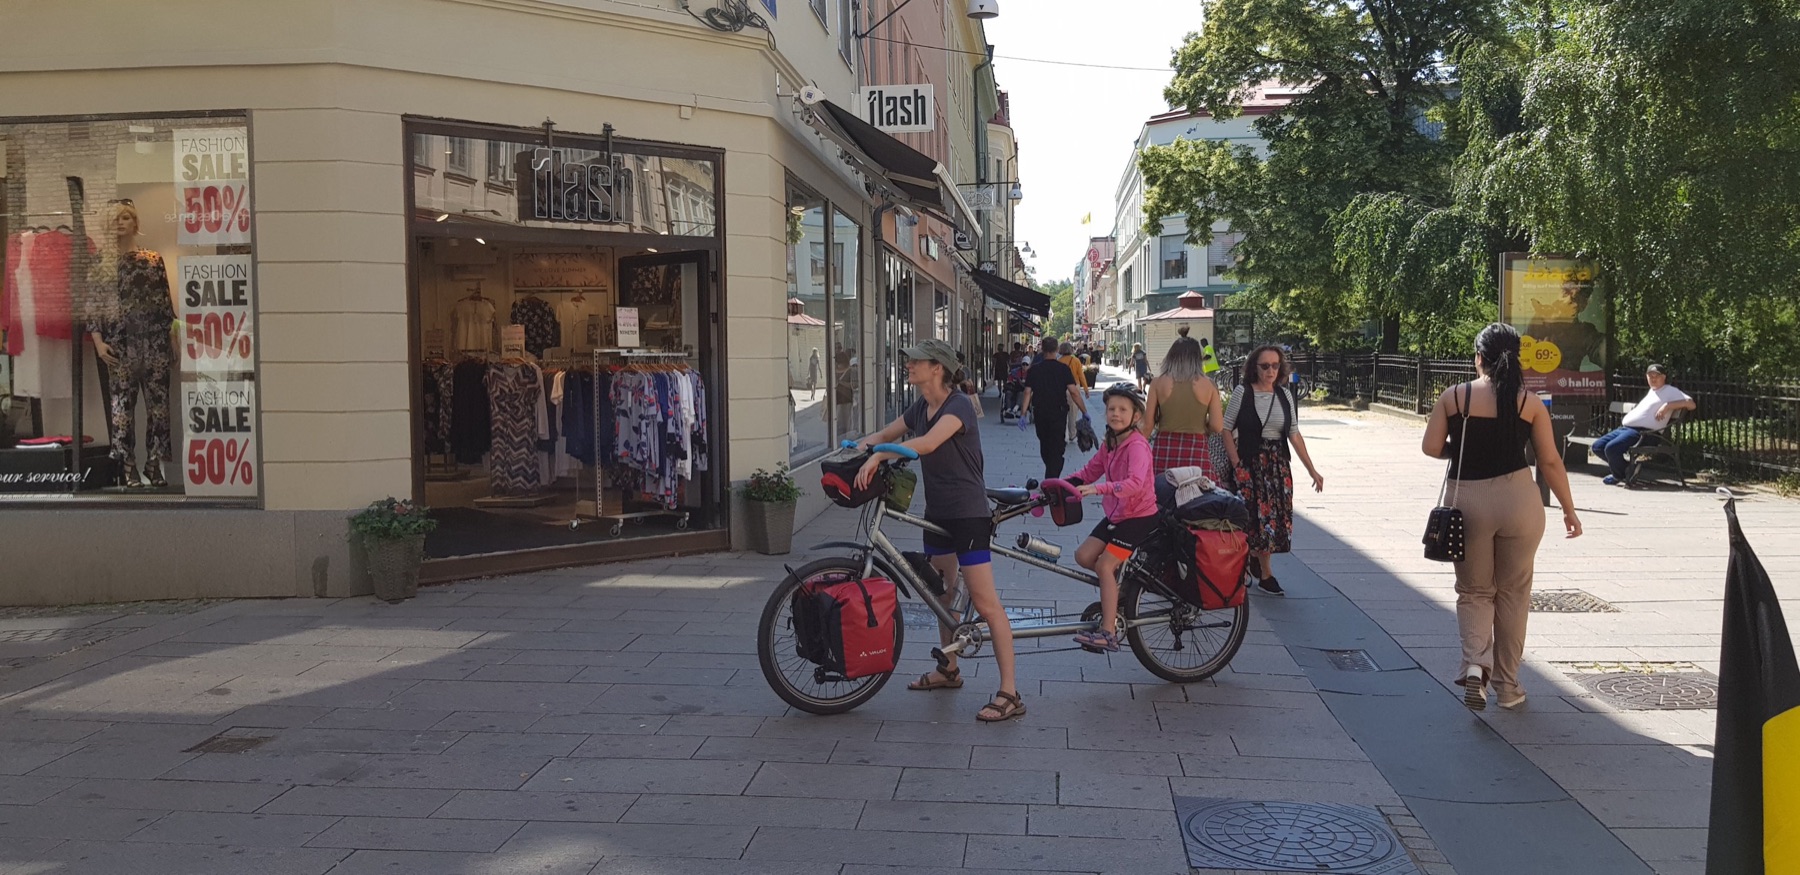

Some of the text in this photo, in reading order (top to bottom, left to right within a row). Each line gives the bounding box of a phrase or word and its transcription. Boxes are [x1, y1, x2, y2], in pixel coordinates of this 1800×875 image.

[867, 88, 927, 127] flash
[181, 136, 246, 153] FASHION
[182, 152, 247, 181] SALE
[531, 147, 634, 223] flash
[183, 184, 250, 234] 50%
[183, 263, 247, 280] FASHION
[184, 279, 248, 308] SALE
[185, 310, 251, 360] 50%
[1535, 348, 1559, 361] 69:-
[1568, 376, 1603, 388] hallon
[187, 389, 251, 406] FASHION
[189, 406, 252, 434] SALE
[26, 466, 92, 483] service!
[188, 437, 254, 487] 50%
